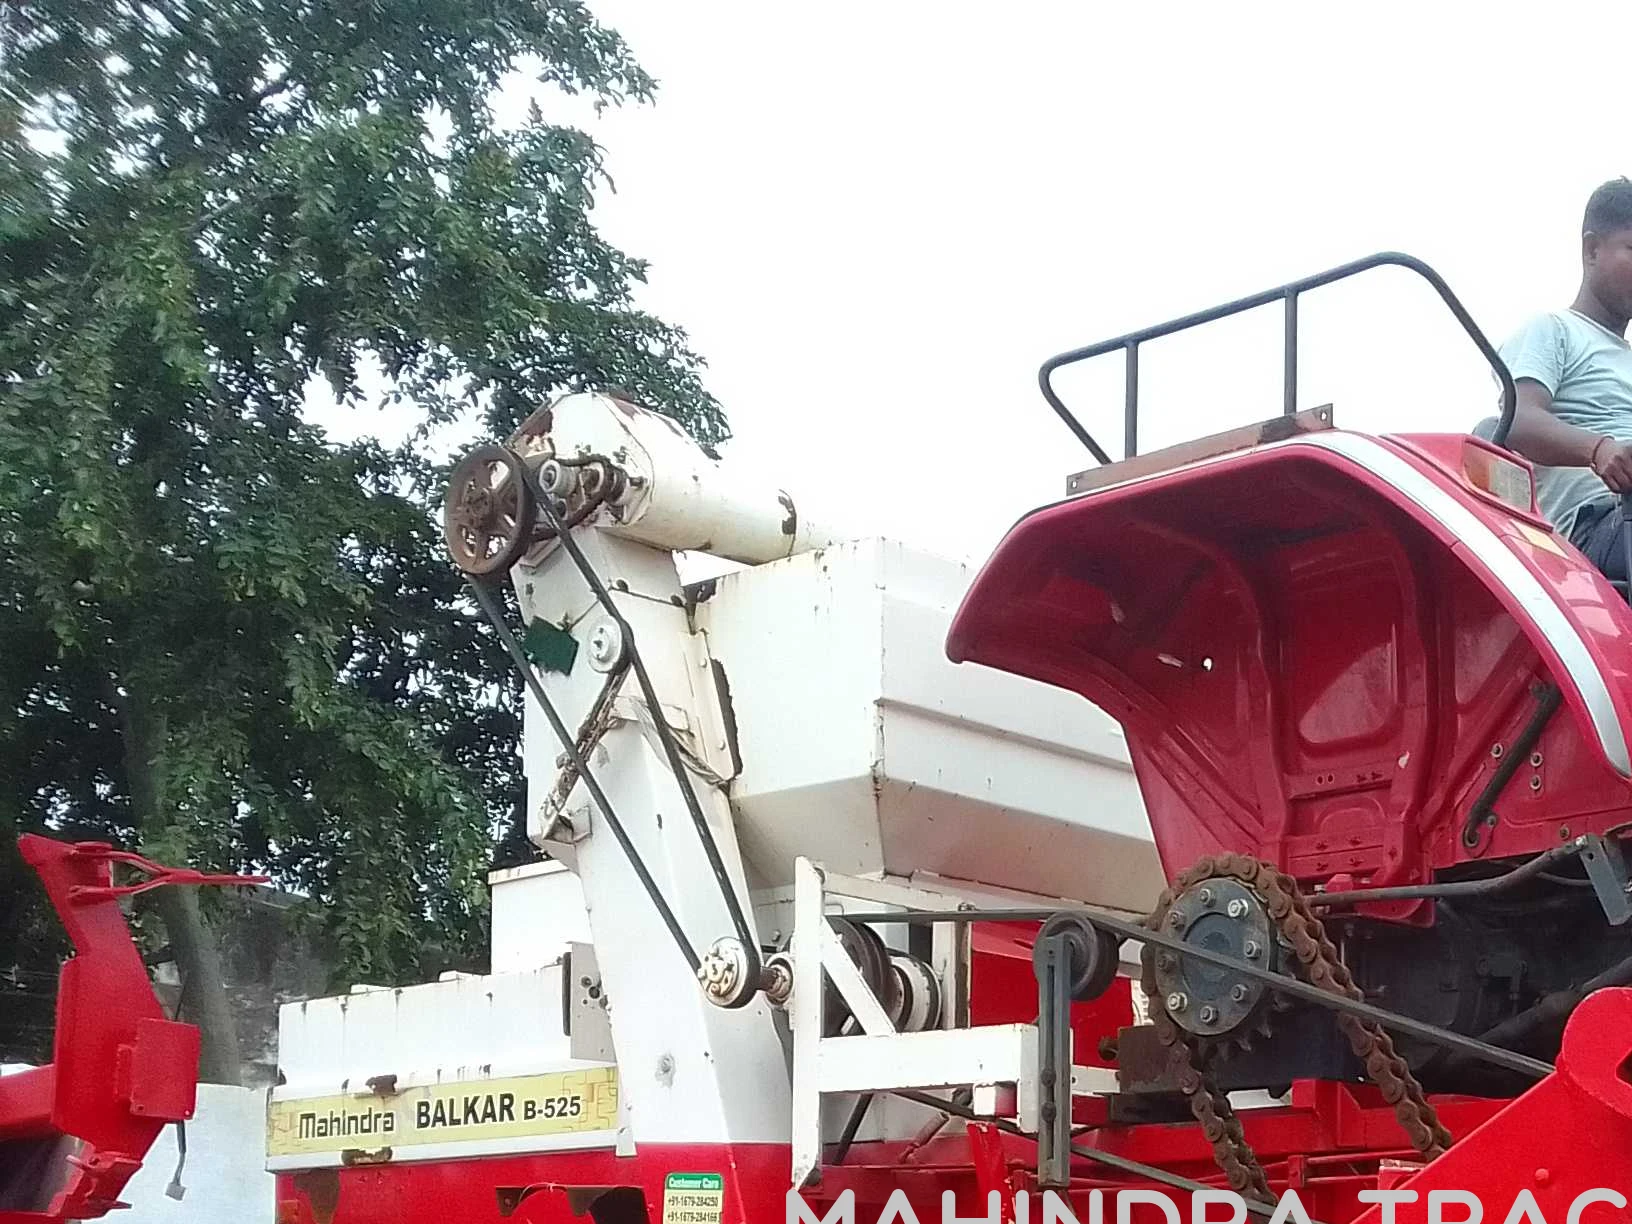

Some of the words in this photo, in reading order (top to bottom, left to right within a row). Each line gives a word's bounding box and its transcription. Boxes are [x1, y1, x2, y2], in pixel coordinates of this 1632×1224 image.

[299, 1107, 395, 1139] Mahindra
[416, 1093, 516, 1129] BALKAR
[523, 1096, 581, 1121] B-525
